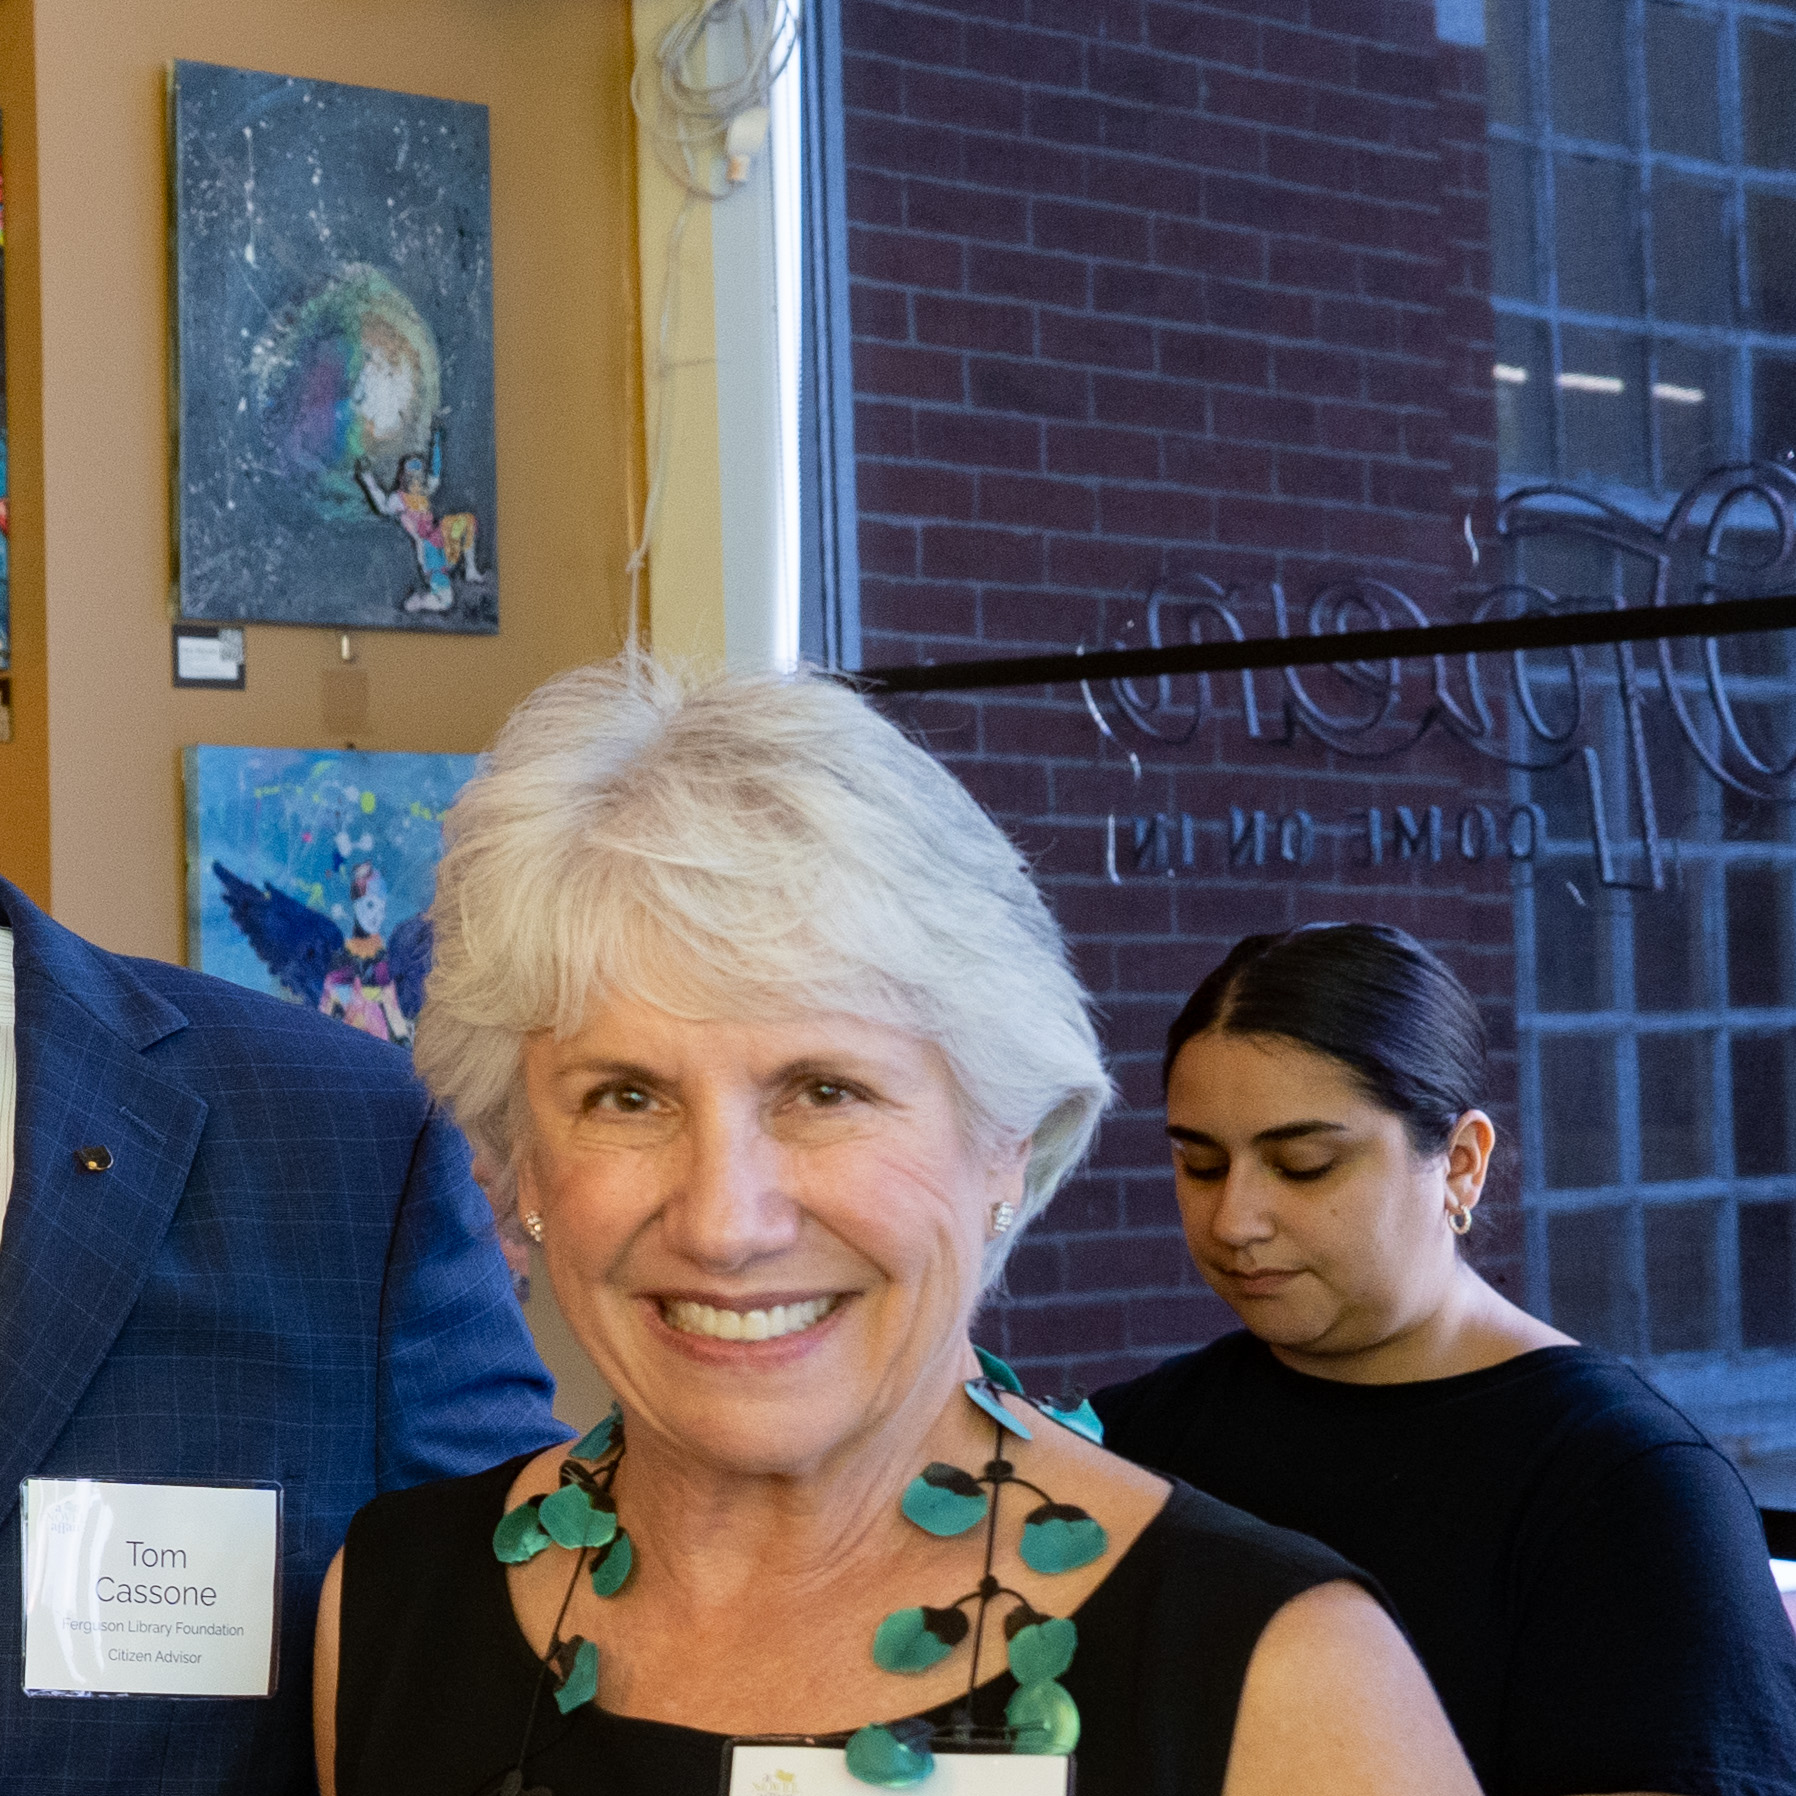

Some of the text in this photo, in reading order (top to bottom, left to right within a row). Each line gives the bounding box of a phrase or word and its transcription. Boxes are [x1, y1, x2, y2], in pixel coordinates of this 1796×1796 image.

[126, 1541, 187, 1568] Tom
[96, 1576, 217, 1606] Cassone
[63, 1617, 244, 1638] Ferguson Library Foundation
[108, 1648, 202, 1664] Citizen Advisor
